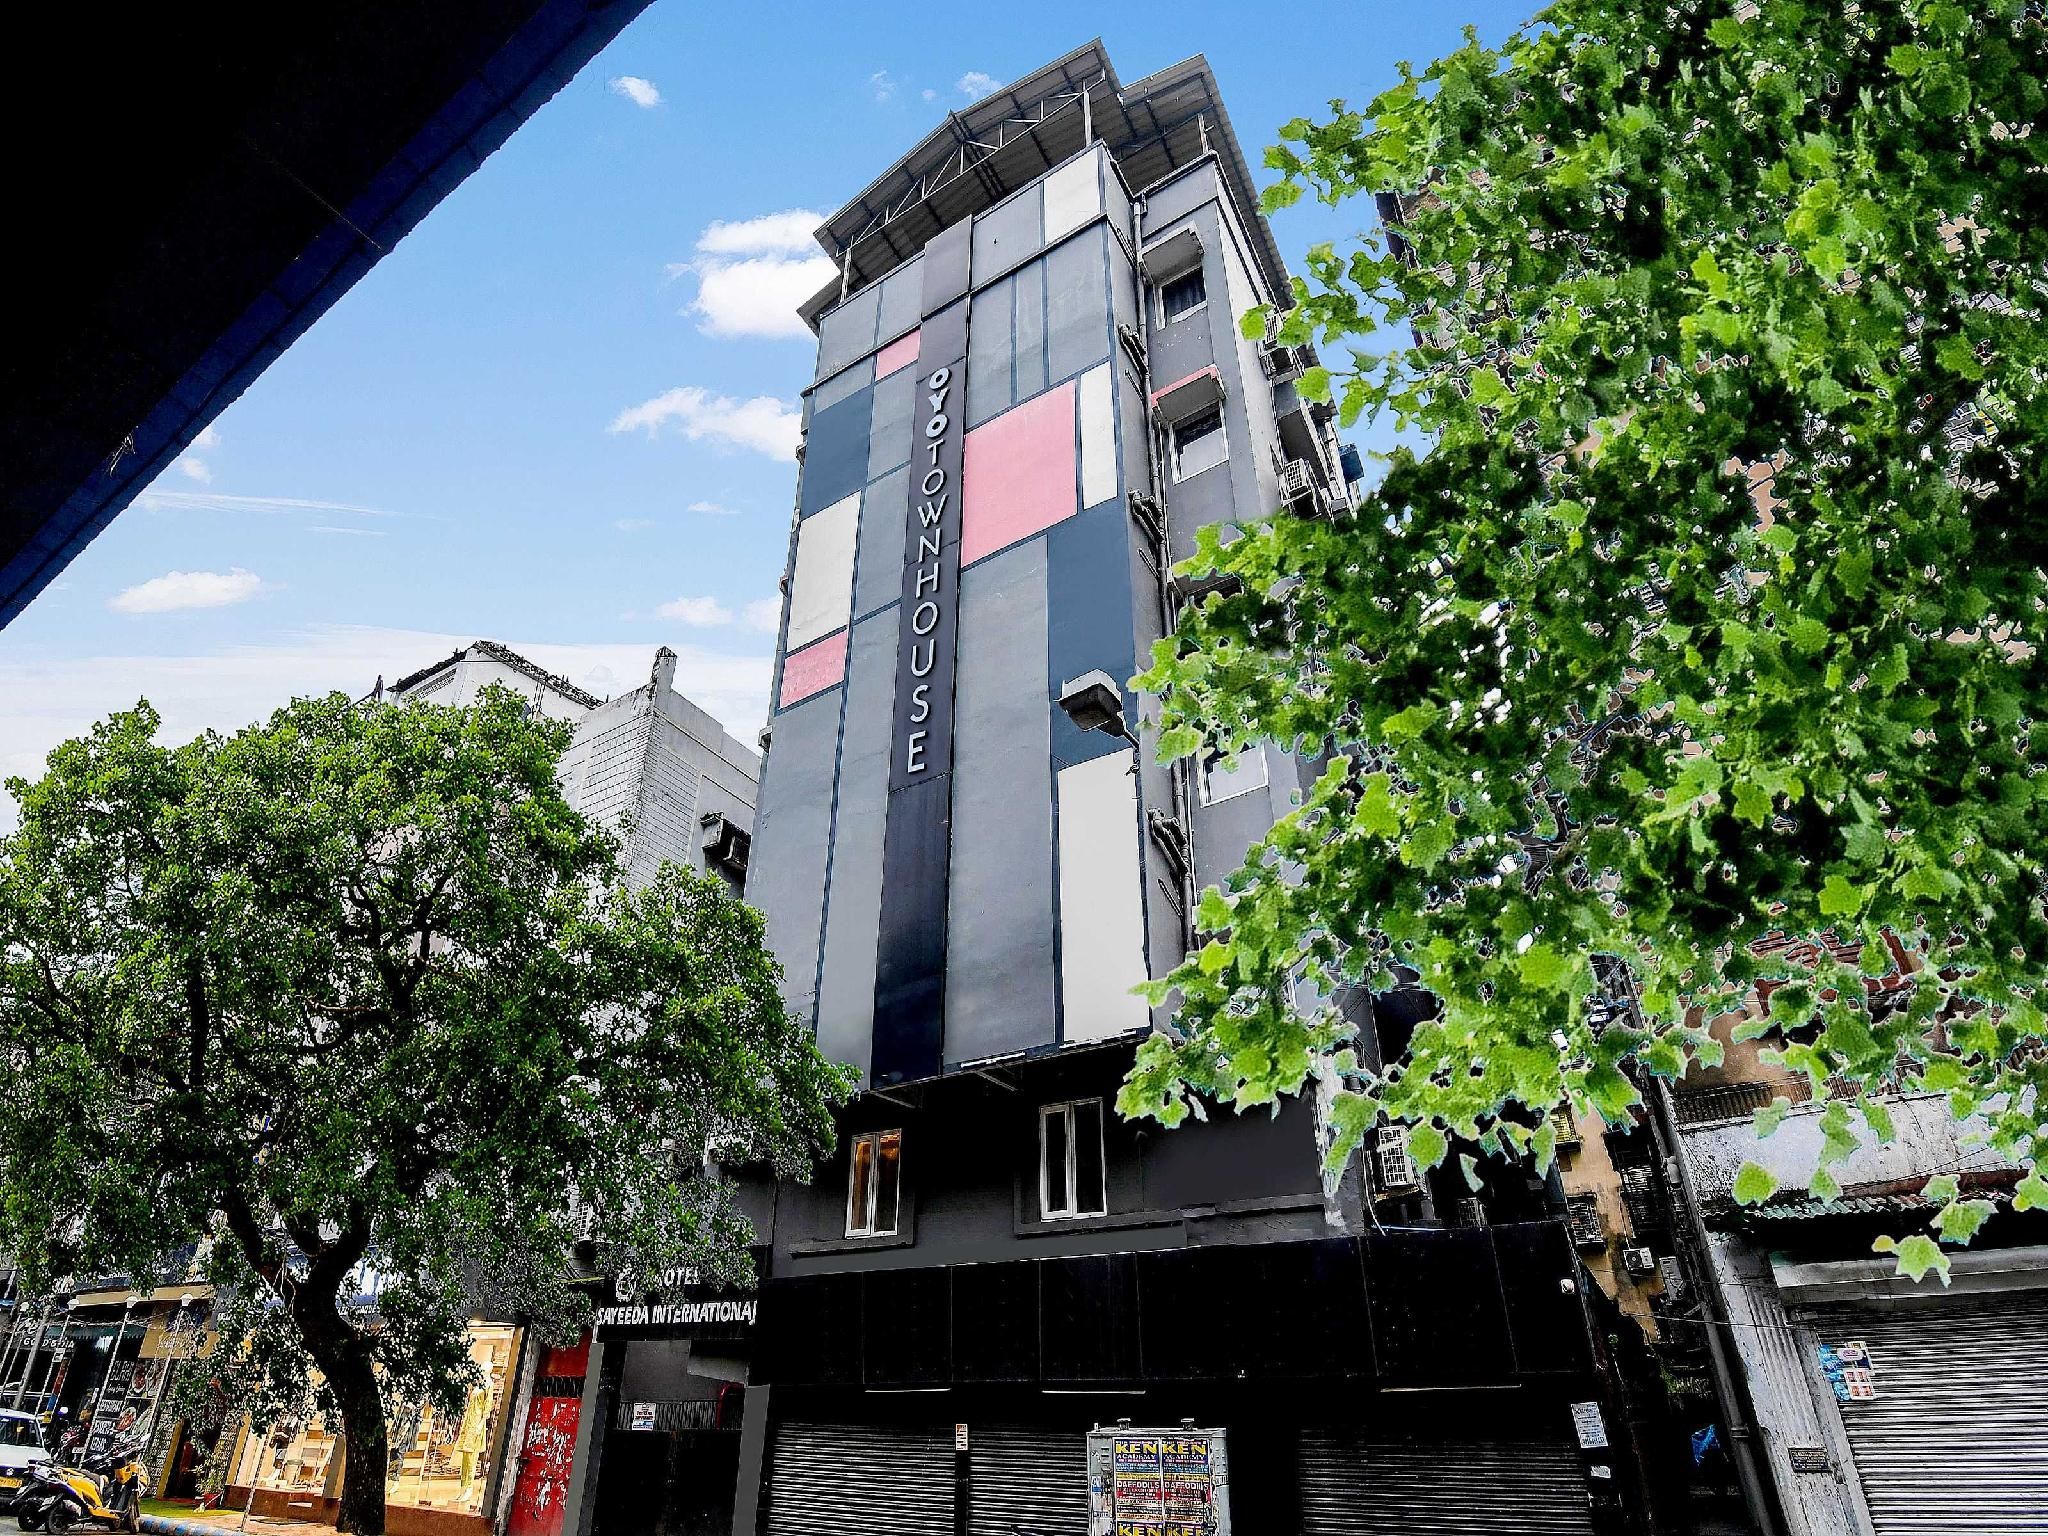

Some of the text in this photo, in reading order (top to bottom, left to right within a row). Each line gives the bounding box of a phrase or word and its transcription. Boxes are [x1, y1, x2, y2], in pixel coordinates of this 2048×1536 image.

[597, 1306, 649, 1325] SAYEEDA
[1115, 1443, 1157, 1454] KEN
[1162, 1443, 1207, 1455] KEN
[1116, 1480, 1160, 1489] DAFFODILS
